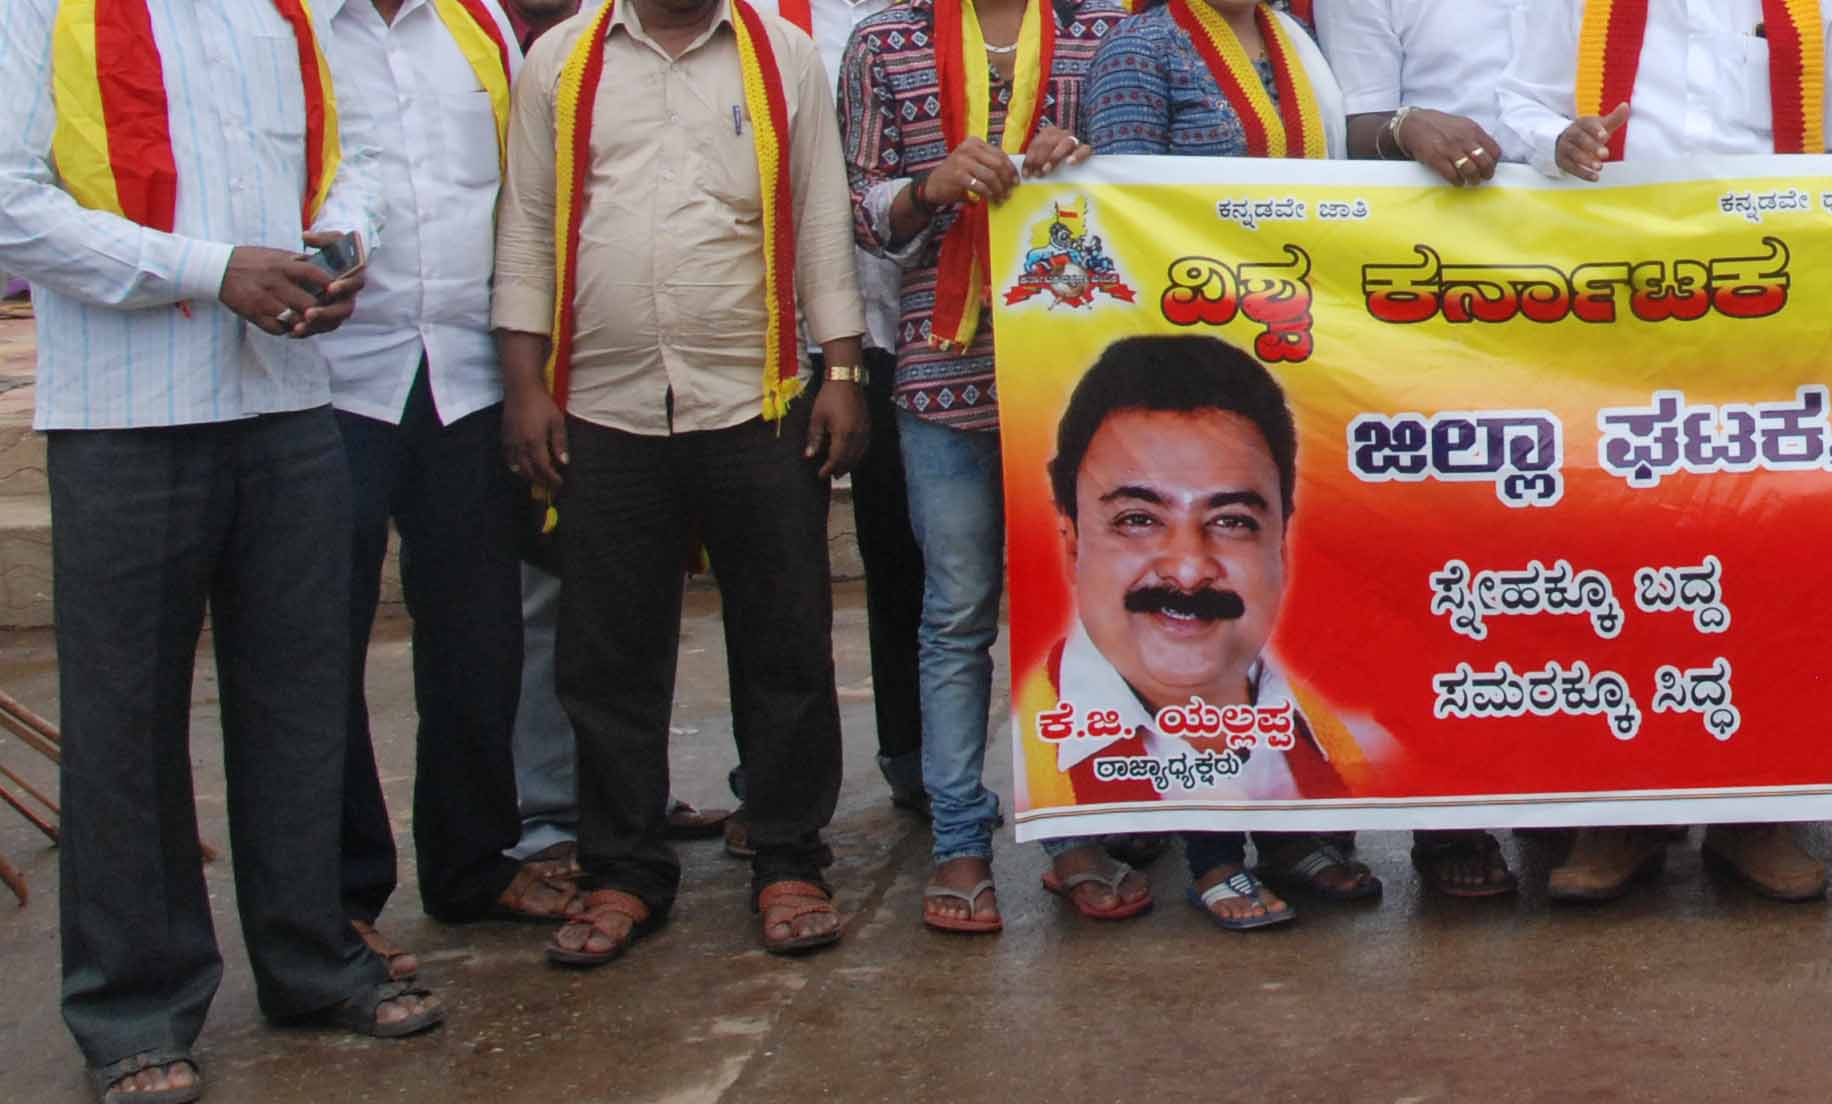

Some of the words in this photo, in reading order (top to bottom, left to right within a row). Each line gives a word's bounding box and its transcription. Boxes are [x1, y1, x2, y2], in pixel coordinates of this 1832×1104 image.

[1218, 197, 1305, 229] ಕನ್ನಡವೇ
[1319, 200, 1368, 219] ಜಾತಿ
[1720, 190, 1808, 221] ಕನ್ನಡವೇ
[1160, 243, 1313, 363] ವಿಶ್ವ
[1361, 236, 1792, 324] ಕರ್ನಾಟಕ
[1353, 417, 1557, 500] ಜಿಲ್ಲಾ
[1435, 564, 1619, 635] ಸ್ನೇಹಕ್ಕೂ
[1158, 699, 1293, 747] ಯಲ್ಲಪ್ಪ
[1438, 666, 1636, 734] ಸಮರಕ್ಕೂ
[1657, 663, 1736, 735] ಸಿದ್ಧ
[1096, 752, 1241, 790] ರಾಜ್ಯಾಧ್ಯಕ್ಷರು
